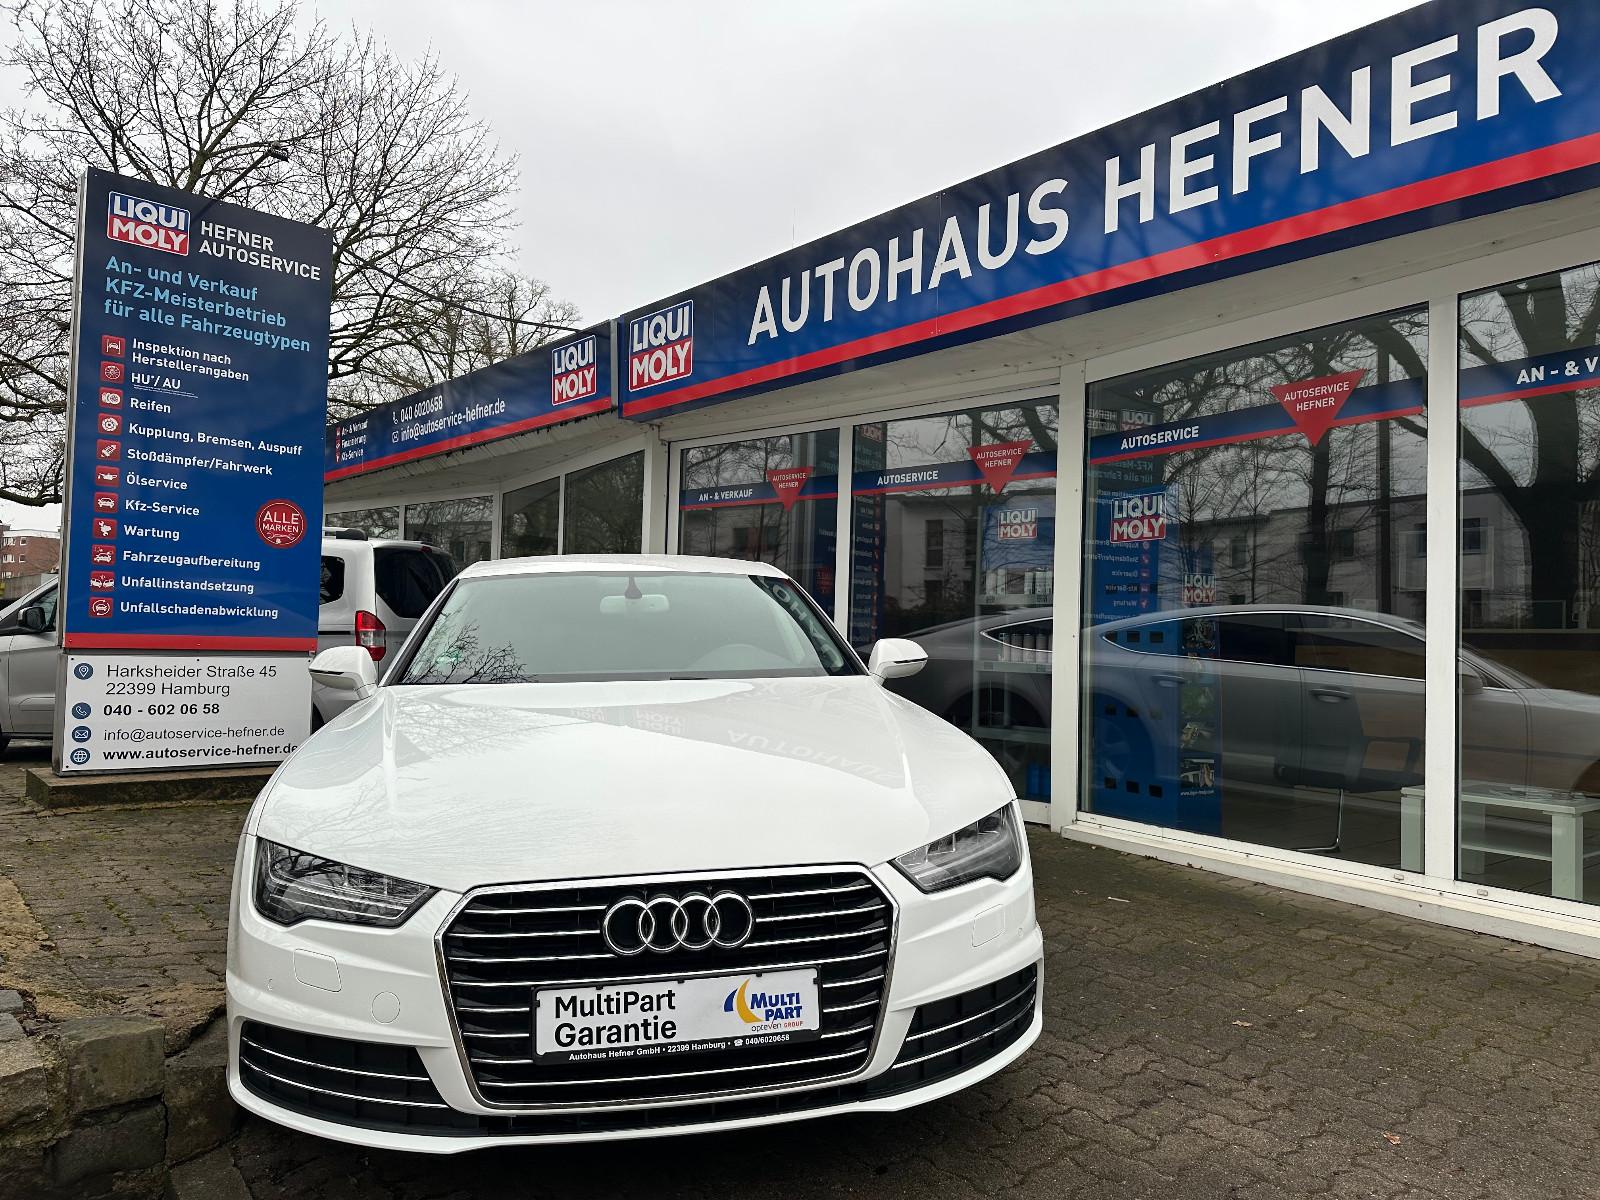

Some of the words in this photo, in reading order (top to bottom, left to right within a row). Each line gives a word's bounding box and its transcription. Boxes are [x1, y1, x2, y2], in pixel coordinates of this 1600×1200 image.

[748, 178, 1069, 345] AUTOHAUS
[1104, 7, 1563, 235] HEFNER
[112, 195, 186, 231] LIQUI
[111, 218, 188, 253] MOLY
[201, 221, 274, 252] HEFNER
[199, 239, 321, 281] AUTOSERVICE
[106, 255, 142, 274] An-
[148, 262, 182, 286] und
[188, 271, 258, 301] Verkauf
[105, 277, 287, 327] KFZ-Meisterbetrieb
[104, 299, 133, 318] für
[139, 305, 175, 327] alle
[181, 313, 310, 352] Fahrzeugtypen
[633, 306, 689, 353] LIQUI
[132, 338, 200, 361] Inspektion
[203, 350, 231, 365] nach
[554, 340, 594, 375] LIQUI
[132, 352, 249, 382] Herstellerangaben
[632, 341, 691, 386] MOLY
[1516, 366, 1545, 384] AN
[1564, 360, 1580, 376] &
[163, 377, 181, 389] AU
[554, 367, 595, 402] MOLY
[1284, 381, 1350, 402] AUTOSERVICE
[130, 397, 171, 413] Reifen
[400, 406, 413, 423] 040
[414, 395, 443, 419] 6020658
[1296, 397, 1335, 412] HEFNER
[400, 398, 506, 441] info@autoservice-hefner.de
[128, 423, 194, 443] Kupplung,
[197, 432, 255, 451] Bremsen,
[258, 440, 303, 456] Auspuff
[1120, 426, 1200, 450] AUTOSERVICE
[127, 448, 273, 476] Stoßdämpfer/Fahrwerk
[976, 447, 1022, 460] AUTOSERVICE
[985, 458, 1012, 468] HEFNER
[126, 471, 188, 490] Ölservice
[772, 472, 806, 482] AUTOSERVICE
[778, 481, 799, 489] HEFNER
[877, 470, 939, 486] AUTOSERVICE
[699, 493, 709, 501] AN
[720, 489, 753, 499] VERKAUF
[125, 500, 200, 516] Kfz-Service
[263, 510, 300, 525] ALLE
[1000, 509, 1036, 524] LIQUI
[1113, 495, 1165, 519] LIQUI
[124, 525, 181, 541] Wartung
[262, 523, 299, 534] MARKEN
[1000, 524, 1037, 538] MOLY
[1113, 517, 1165, 540] MOLY
[123, 550, 261, 571] Fahrzeugaufbereitung
[121, 576, 254, 594] Unfallinstandsetzung
[120, 601, 279, 619] Unfallschadenabwicklung
[107, 664, 203, 679] Harksheider
[206, 665, 255, 678] Straße
[259, 665, 277, 677] 45
[105, 683, 156, 695] 22399
[161, 682, 231, 697] Hamburg
[103, 704, 132, 716] 040
[147, 704, 175, 716] 602
[180, 704, 199, 716] 06
[202, 703, 220, 715] 58
[104, 725, 285, 743] info@autoservice-hefner.de
[555, 989, 676, 1019] MultiPart
[765, 1005, 803, 1021] PART
[554, 1015, 677, 1047] Garantie
[783, 1020, 804, 1029] GROUP
[569, 1051, 607, 1061] Autohaus
[608, 1048, 635, 1058] Hefner
[636, 1046, 661, 1056] GmbH
[667, 1043, 690, 1053] 22399
[691, 1040, 726, 1052] Hamburg
[745, 1033, 790, 1045] 040/6020658
